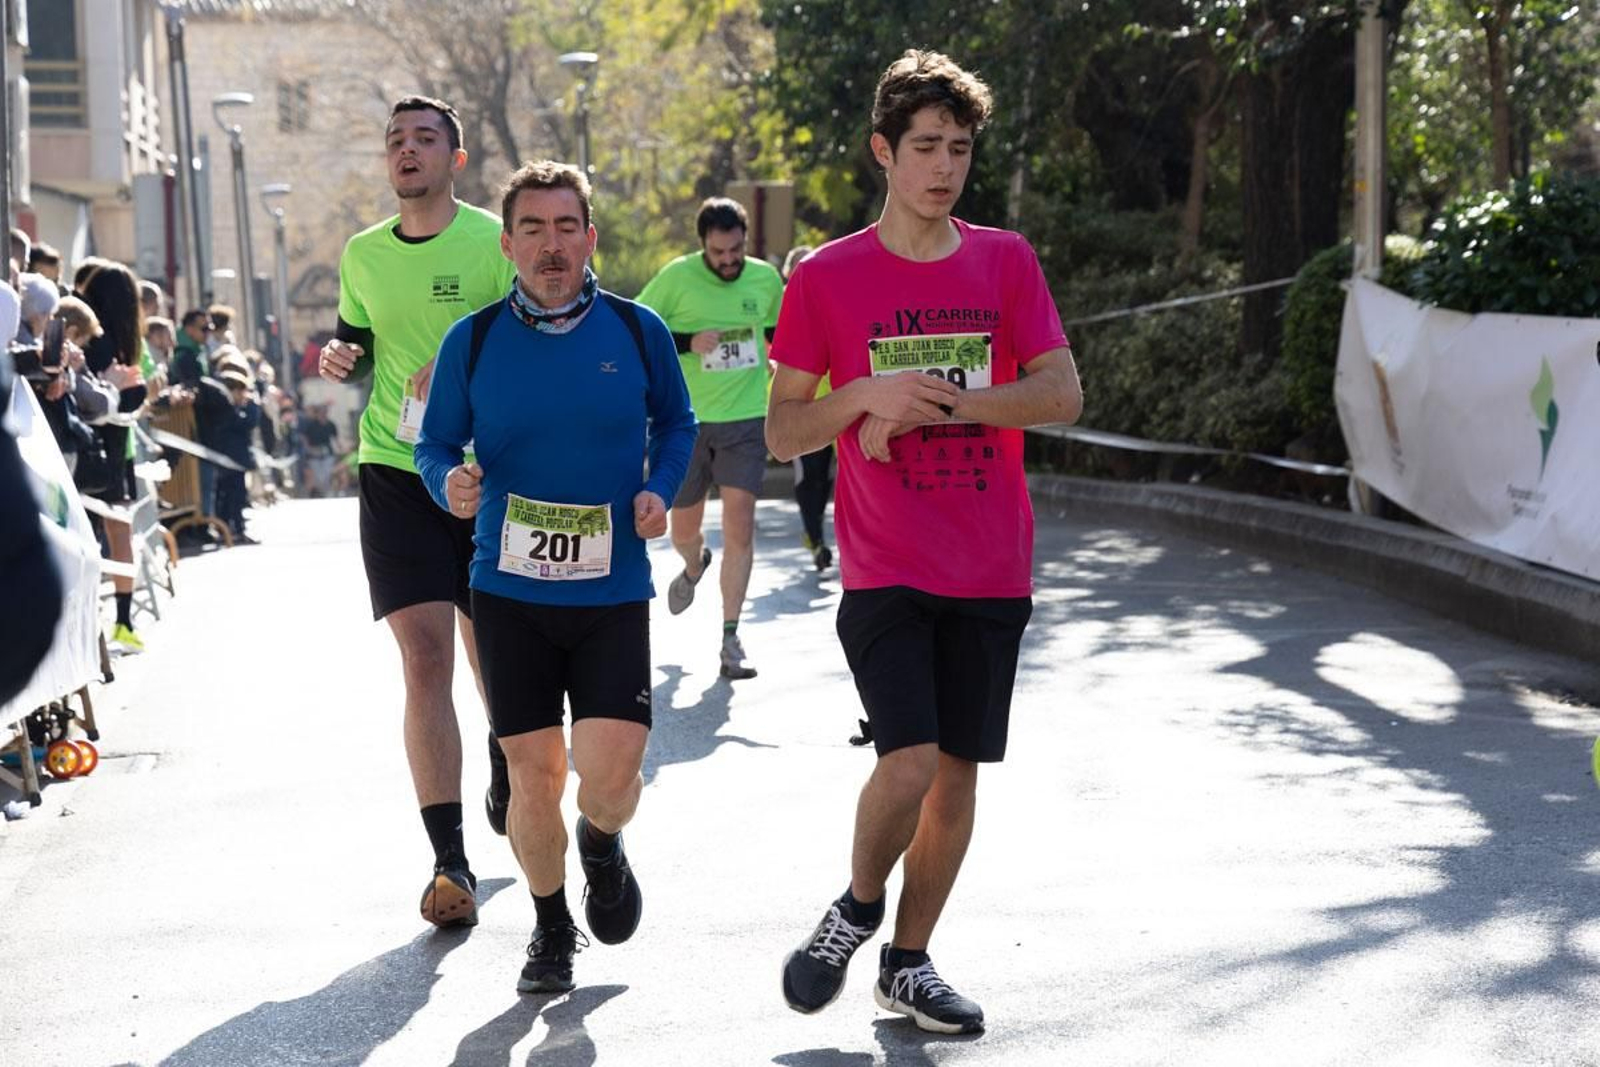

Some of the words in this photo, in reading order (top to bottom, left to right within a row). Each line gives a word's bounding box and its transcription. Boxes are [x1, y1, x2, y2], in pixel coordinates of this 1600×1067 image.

[895, 309, 925, 334] IX
[926, 309, 1000, 320] CARRERA
[720, 342, 739, 360] 34
[893, 341, 909, 353] SAN
[912, 339, 931, 351] JUAN
[933, 339, 955, 350] BOSCO
[890, 353, 921, 365] CARRERA
[923, 351, 950, 363] POPULAR
[529, 530, 581, 562] 201
